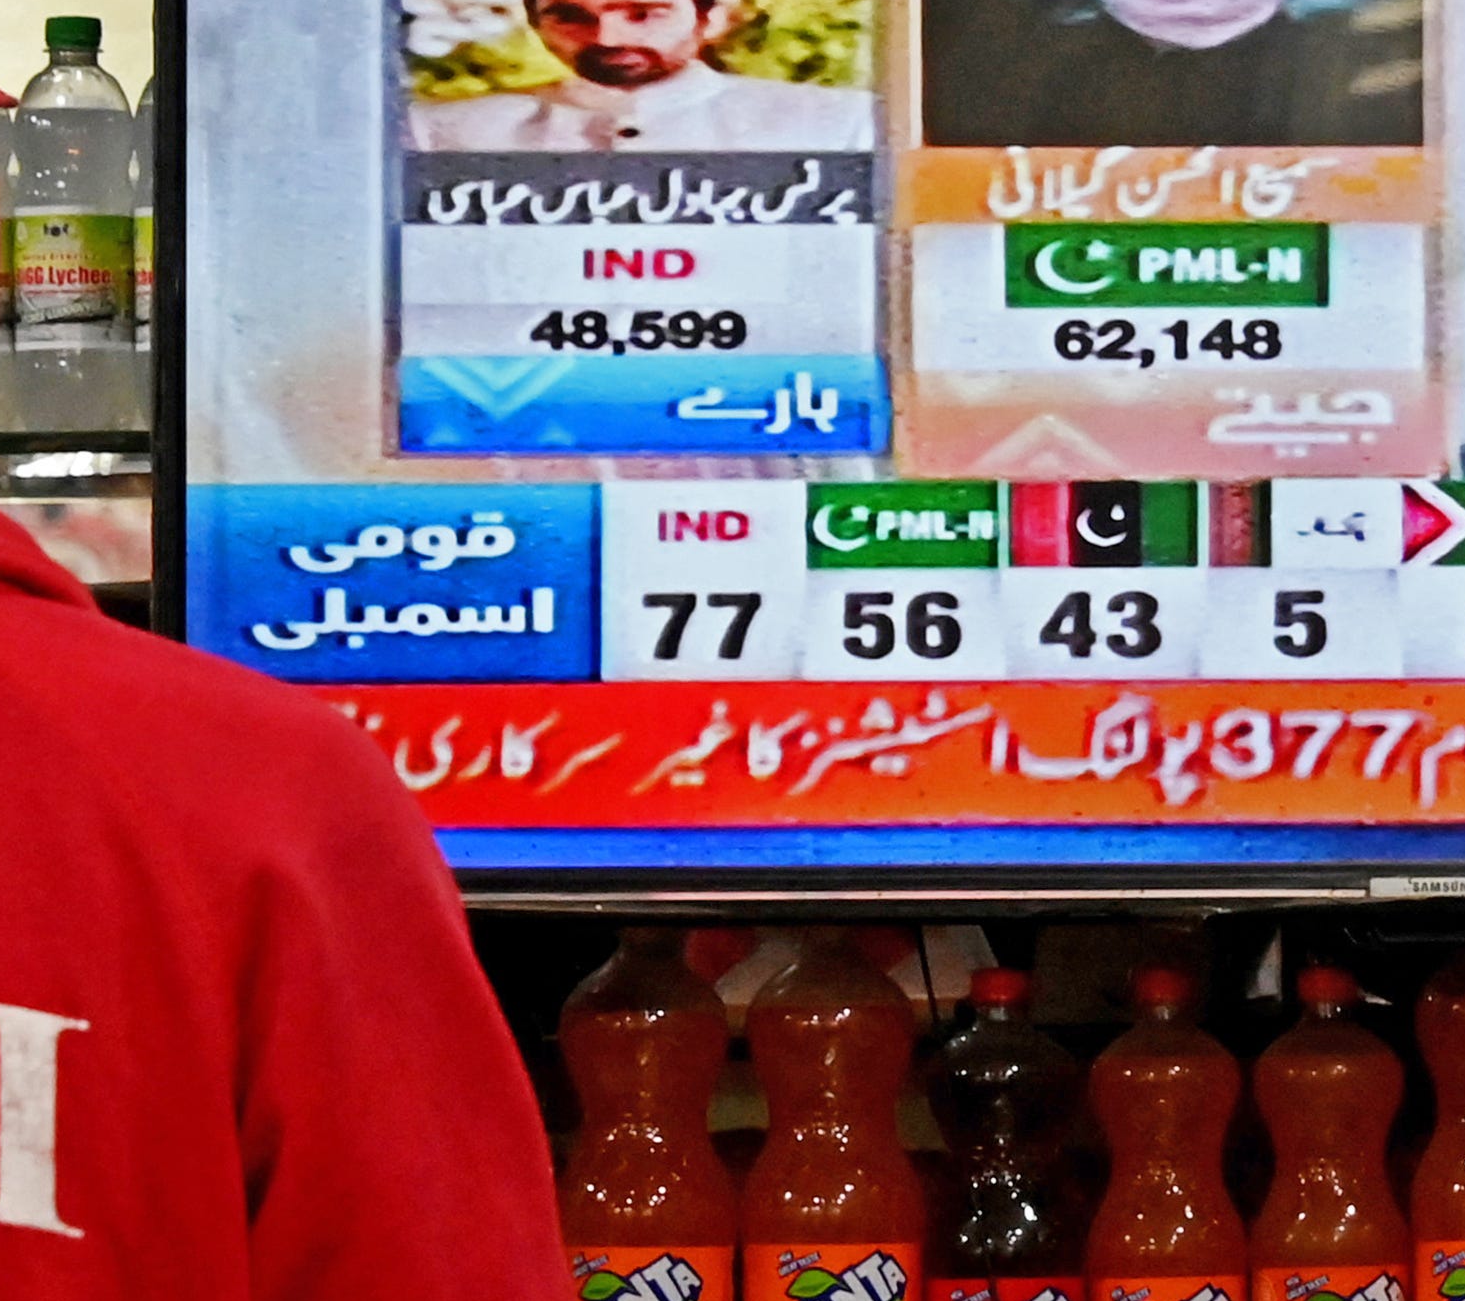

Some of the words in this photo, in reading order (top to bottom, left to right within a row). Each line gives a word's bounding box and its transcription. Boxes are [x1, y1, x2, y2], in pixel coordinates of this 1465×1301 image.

[48, 265, 111, 286] Lychee
[583, 248, 696, 281] IND
[1139, 247, 1302, 286] PML-N
[530, 307, 748, 357] 48,599
[1053, 318, 1282, 367] 62,148
[677, 372, 840, 436] ہارے
[1206, 386, 1394, 457] جیتے
[288, 511, 517, 573] قومی
[658, 509, 751, 543] IND
[874, 509, 997, 543] PML-N
[250, 588, 555, 650] اسمبلی
[642, 592, 763, 661] 77
[842, 591, 963, 661] 56
[1038, 590, 1163, 659] 43
[1273, 589, 1327, 658] 5
[628, 700, 731, 796] غیر
[746, 711, 811, 777] کا
[1210, 708, 1419, 779] 377
